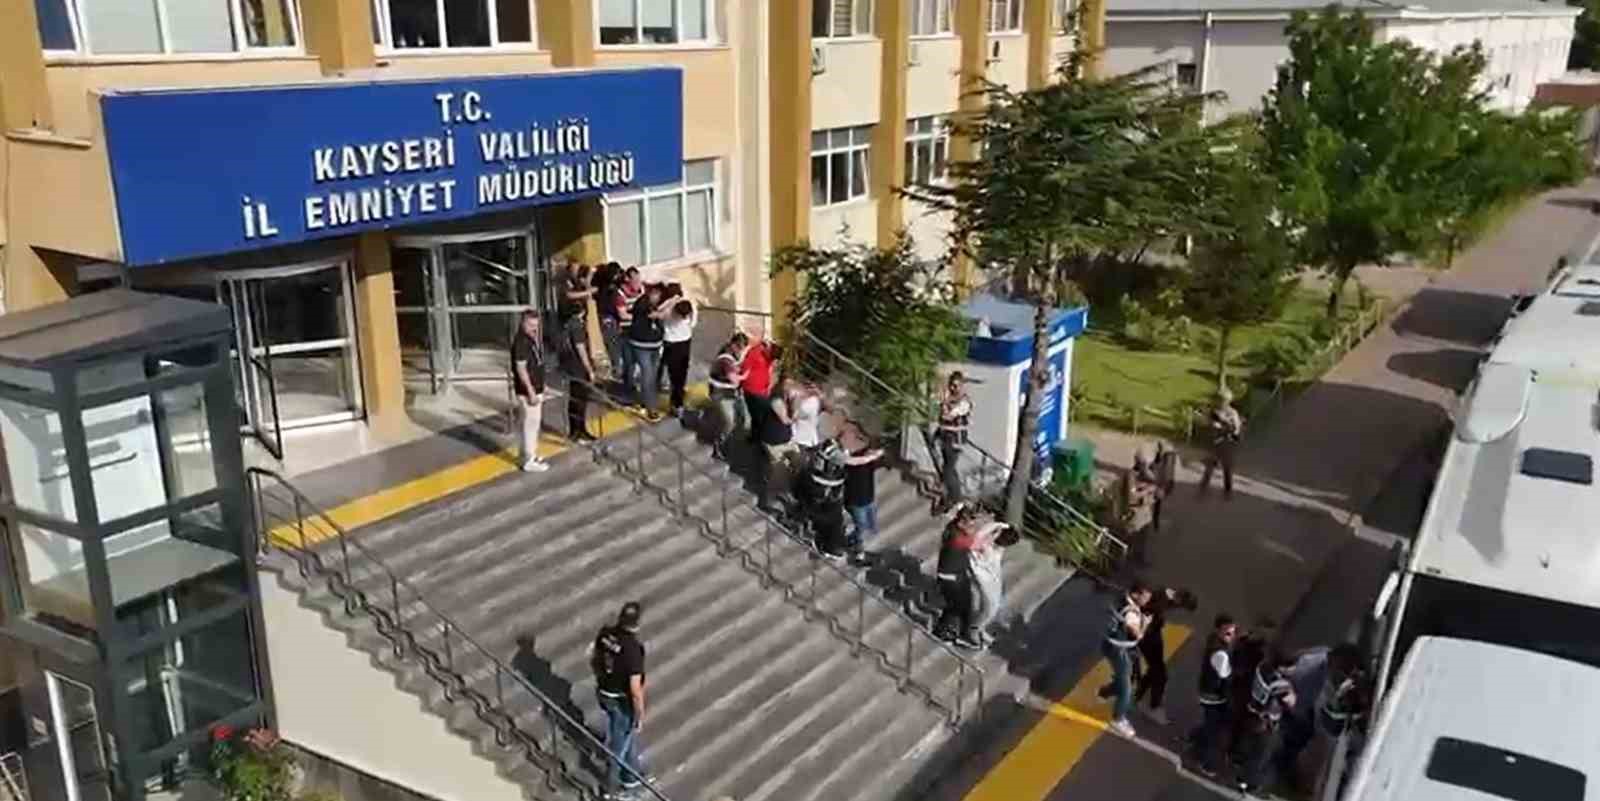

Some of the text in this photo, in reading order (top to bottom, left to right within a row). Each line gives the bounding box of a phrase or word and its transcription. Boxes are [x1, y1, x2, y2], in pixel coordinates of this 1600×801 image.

[437, 92, 493, 123] T.C.
[314, 117, 590, 181] KAYSERİ VALİLİĞİ
[243, 151, 635, 238] İL EMNİYET MÜDÜRLÜĞÜ
